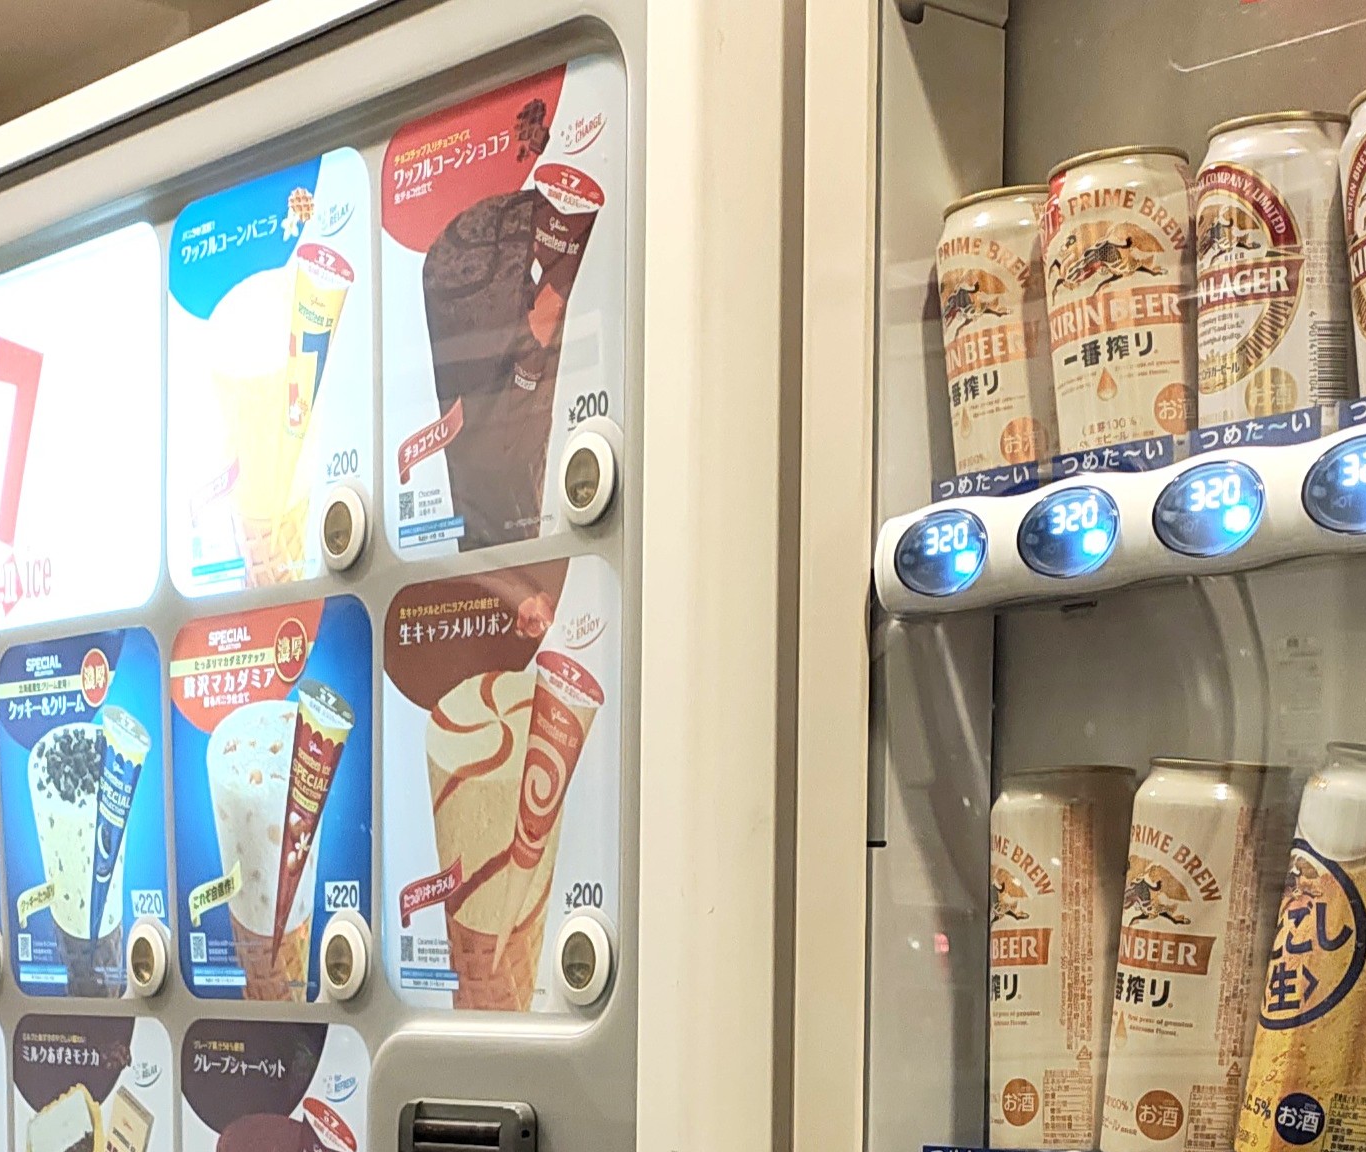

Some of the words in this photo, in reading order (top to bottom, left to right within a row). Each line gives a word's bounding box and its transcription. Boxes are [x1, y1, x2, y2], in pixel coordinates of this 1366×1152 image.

[393, 130, 511, 190] ワッフルコーンショコラ
[1068, 188, 1135, 217] PRIME
[1138, 195, 1187, 251] BREW
[1252, 187, 1287, 235] LIMITED
[181, 215, 278, 265] ワッフルコーンバニラ
[1050, 298, 1102, 344] KIRIN
[1110, 292, 1182, 322] BEER
[567, 389, 609, 425] ¥200
[404, 422, 449, 464] チョコづくし
[327, 448, 359, 477] ¥200
[1190, 478, 1242, 513] 320
[1051, 502, 1099, 535] 320
[925, 525, 968, 556] 320
[26, 548, 52, 598] ice
[208, 626, 251, 646] SPECIAL
[399, 612, 514, 647] 生キャラメルリボン
[575, 617, 601, 641] ENJOY
[26, 655, 62, 672] SPECIAL
[277, 635, 303, 664] 濃厚
[184, 668, 275, 698] 贅沢マカダミア
[9, 693, 85, 720] クッキー&クリーム
[1003, 846, 1055, 896] BREW
[1130, 823, 1174, 856] PRIME
[1172, 844, 1222, 902] BREW
[135, 891, 162, 915] ¥220
[327, 884, 358, 908] ¥220
[565, 882, 604, 909] ¥200
[992, 937, 1039, 961] BEER
[1135, 939, 1197, 967] BEER
[22, 1045, 100, 1067] ミルクあずきモナカ
[193, 1054, 286, 1079] グレープシャーベット
[1004, 1091, 1036, 1112] お酒
[1138, 1103, 1180, 1128] お酒
[1278, 1105, 1320, 1133] お酒
